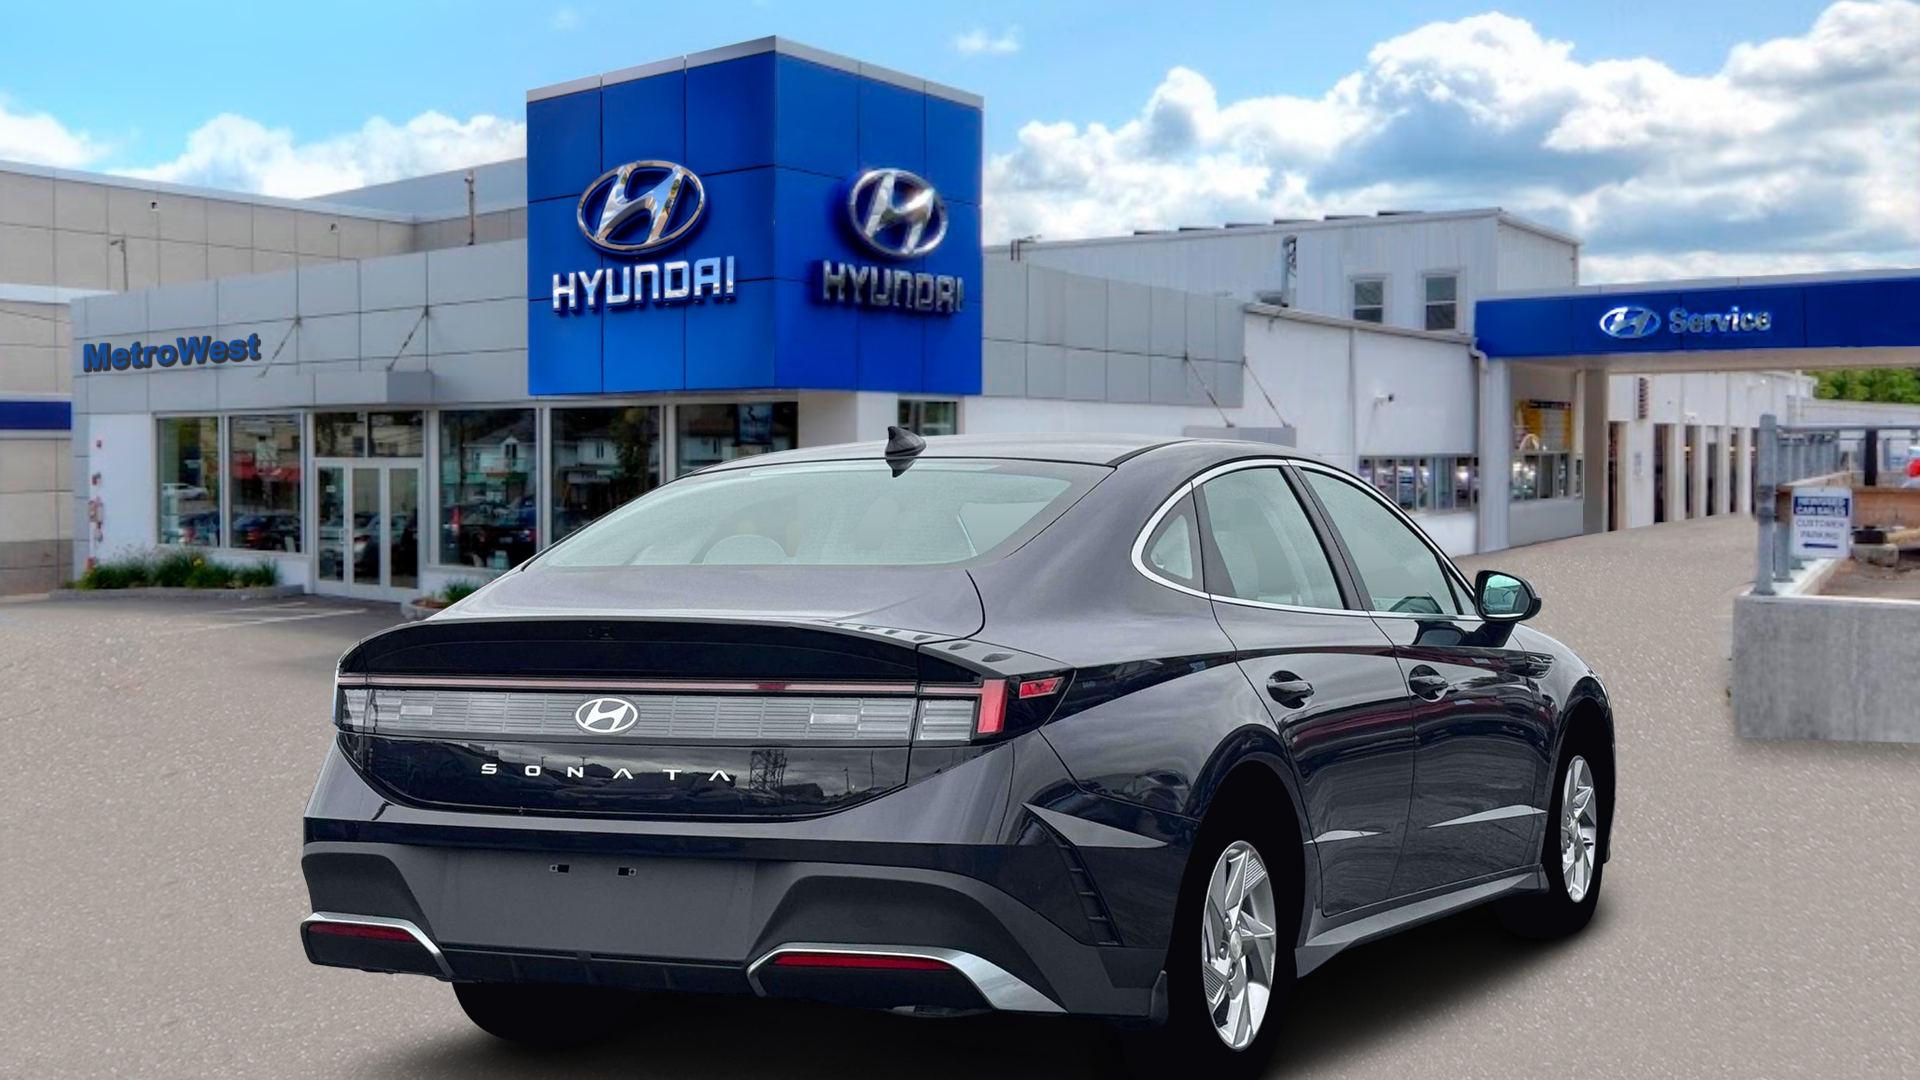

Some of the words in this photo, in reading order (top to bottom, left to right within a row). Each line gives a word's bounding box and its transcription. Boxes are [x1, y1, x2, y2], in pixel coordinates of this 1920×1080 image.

[552, 256, 735, 310] HYUNDAI
[823, 260, 965, 313] HYUNDAI
[1669, 306, 1771, 333] Service
[83, 333, 262, 372] MetroWest
[1796, 506, 1816, 515] CAR
[1817, 506, 1845, 517] SALES
[1796, 519, 1844, 528] CUSTOMER
[1800, 530, 1840, 540] PARKING
[481, 763, 730, 782] SONATA
